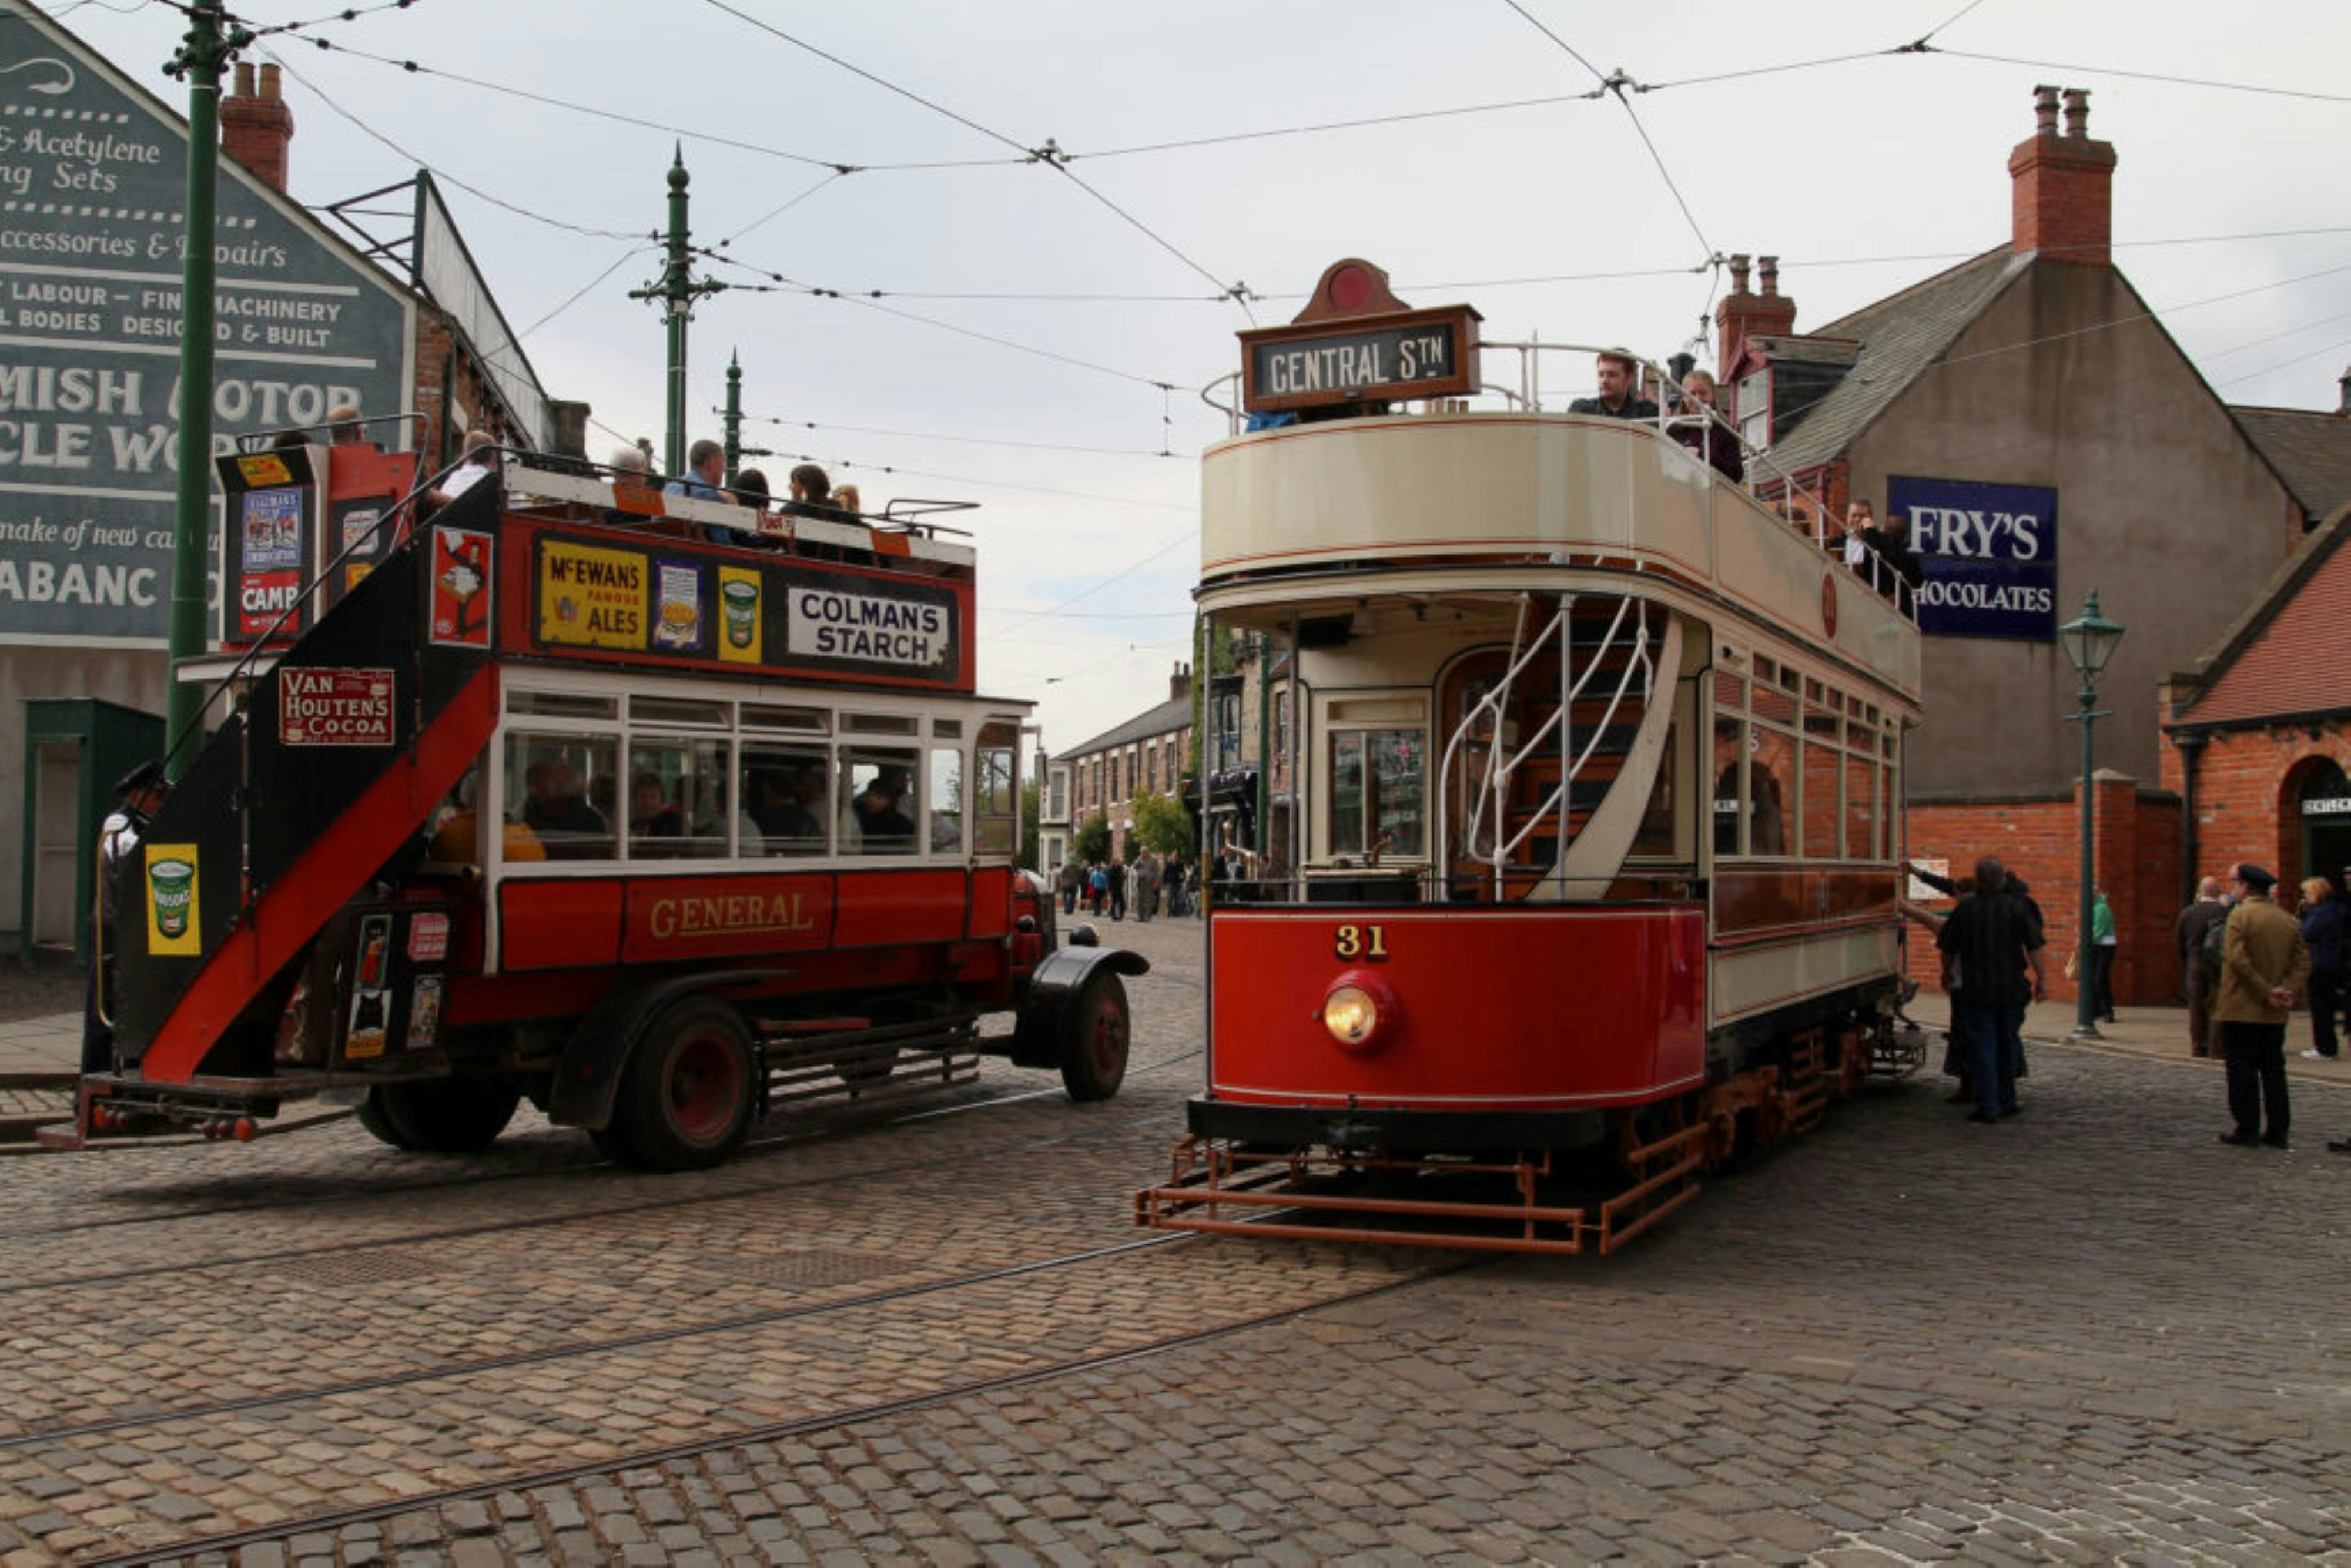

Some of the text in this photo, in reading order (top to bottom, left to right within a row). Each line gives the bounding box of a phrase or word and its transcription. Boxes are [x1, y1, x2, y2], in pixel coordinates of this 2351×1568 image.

[20, 129, 160, 165] Acetylene
[53, 162, 119, 192] Sets
[147, 232, 170, 259] &
[176, 236, 287, 267] pairs
[12, 282, 108, 305] LABOUR
[142, 290, 182, 310] FIN
[19, 309, 101, 333] BODIES
[122, 315, 232, 340] DESID
[242, 324, 259, 343] &
[267, 327, 331, 347] BUILT
[1270, 343, 1389, 393] CENTRAL
[168, 376, 361, 426] OTO
[63, 520, 93, 551] of
[93, 527, 138, 547] new
[1906, 505, 2039, 561] FRY'S
[242, 585, 299, 612] CAMP
[588, 590, 641, 607] FAMOUS
[1914, 579, 2052, 613] HOCOLATES
[587, 607, 639, 635] ALES
[800, 593, 939, 634] COLMAN'S
[815, 625, 928, 661] STARCH
[283, 673, 333, 696] VAN
[286, 696, 389, 719] HOUTEN'S
[308, 717, 386, 735] COCOA
[650, 893, 813, 939] GENERAL
[1335, 924, 1387, 958] 31
